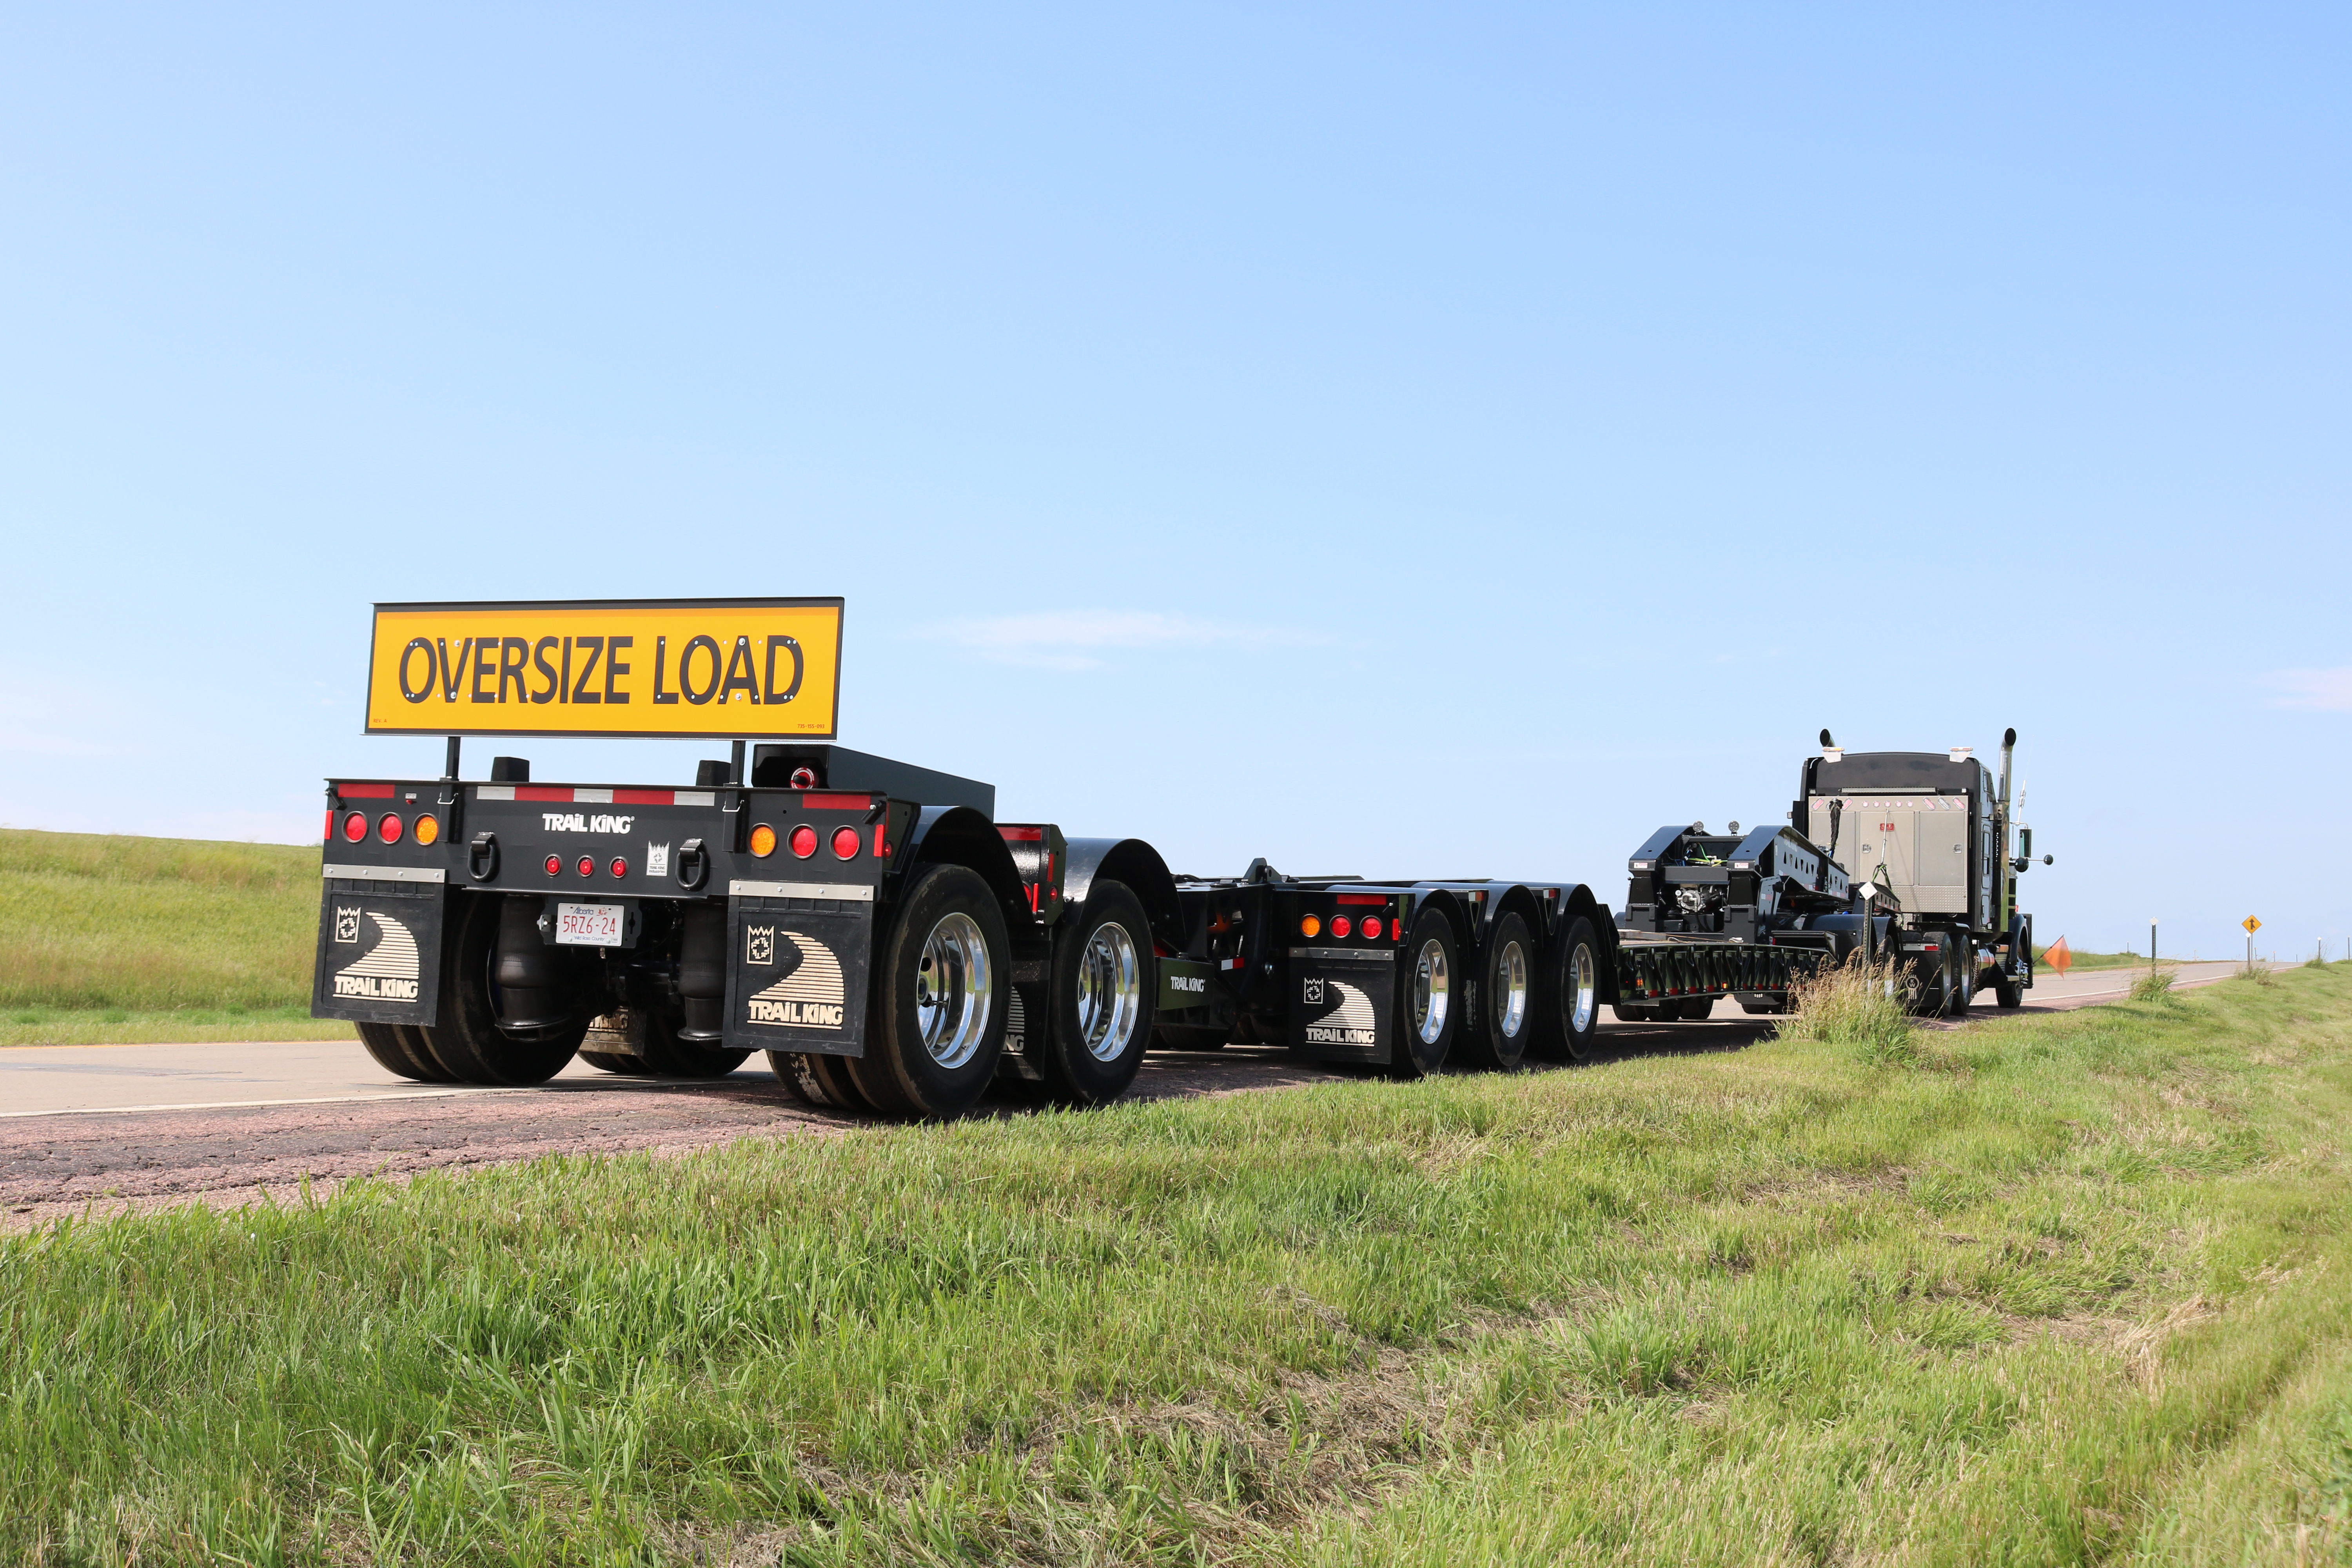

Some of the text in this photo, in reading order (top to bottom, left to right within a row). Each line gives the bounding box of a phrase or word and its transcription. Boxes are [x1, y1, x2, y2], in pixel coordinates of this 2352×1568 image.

[399, 635, 804, 705] OVERSIZE LOAD
[573, 906, 594, 915] Alberta
